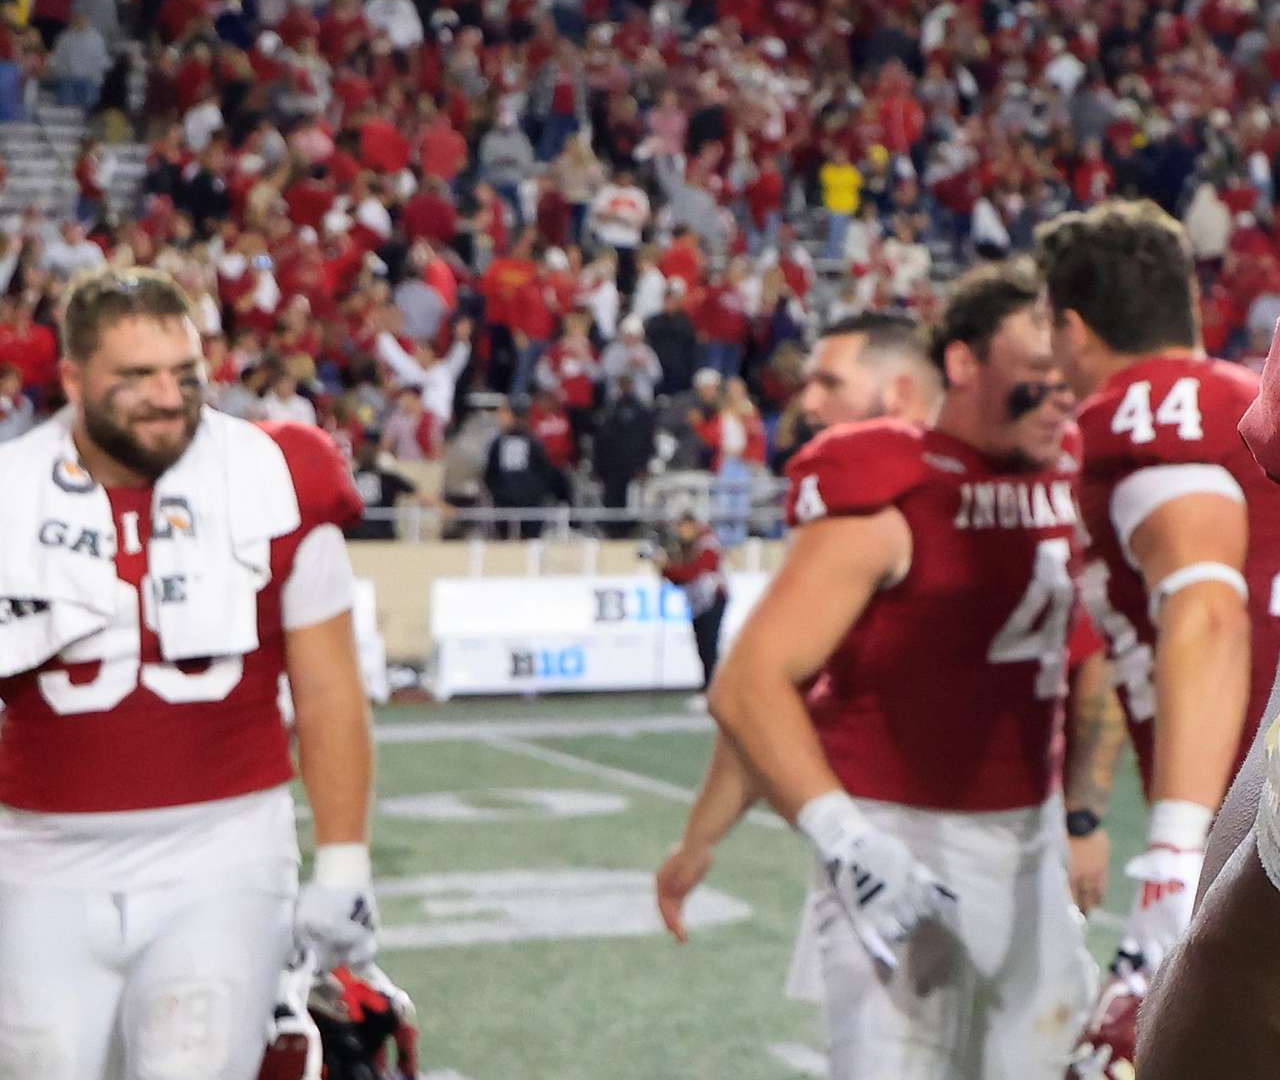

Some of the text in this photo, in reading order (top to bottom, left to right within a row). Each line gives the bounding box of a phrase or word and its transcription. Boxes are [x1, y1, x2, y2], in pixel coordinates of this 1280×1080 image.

[1110, 376, 1204, 444] 44
[953, 480, 1088, 534] INDIAN
[986, 537, 1074, 700] 4
